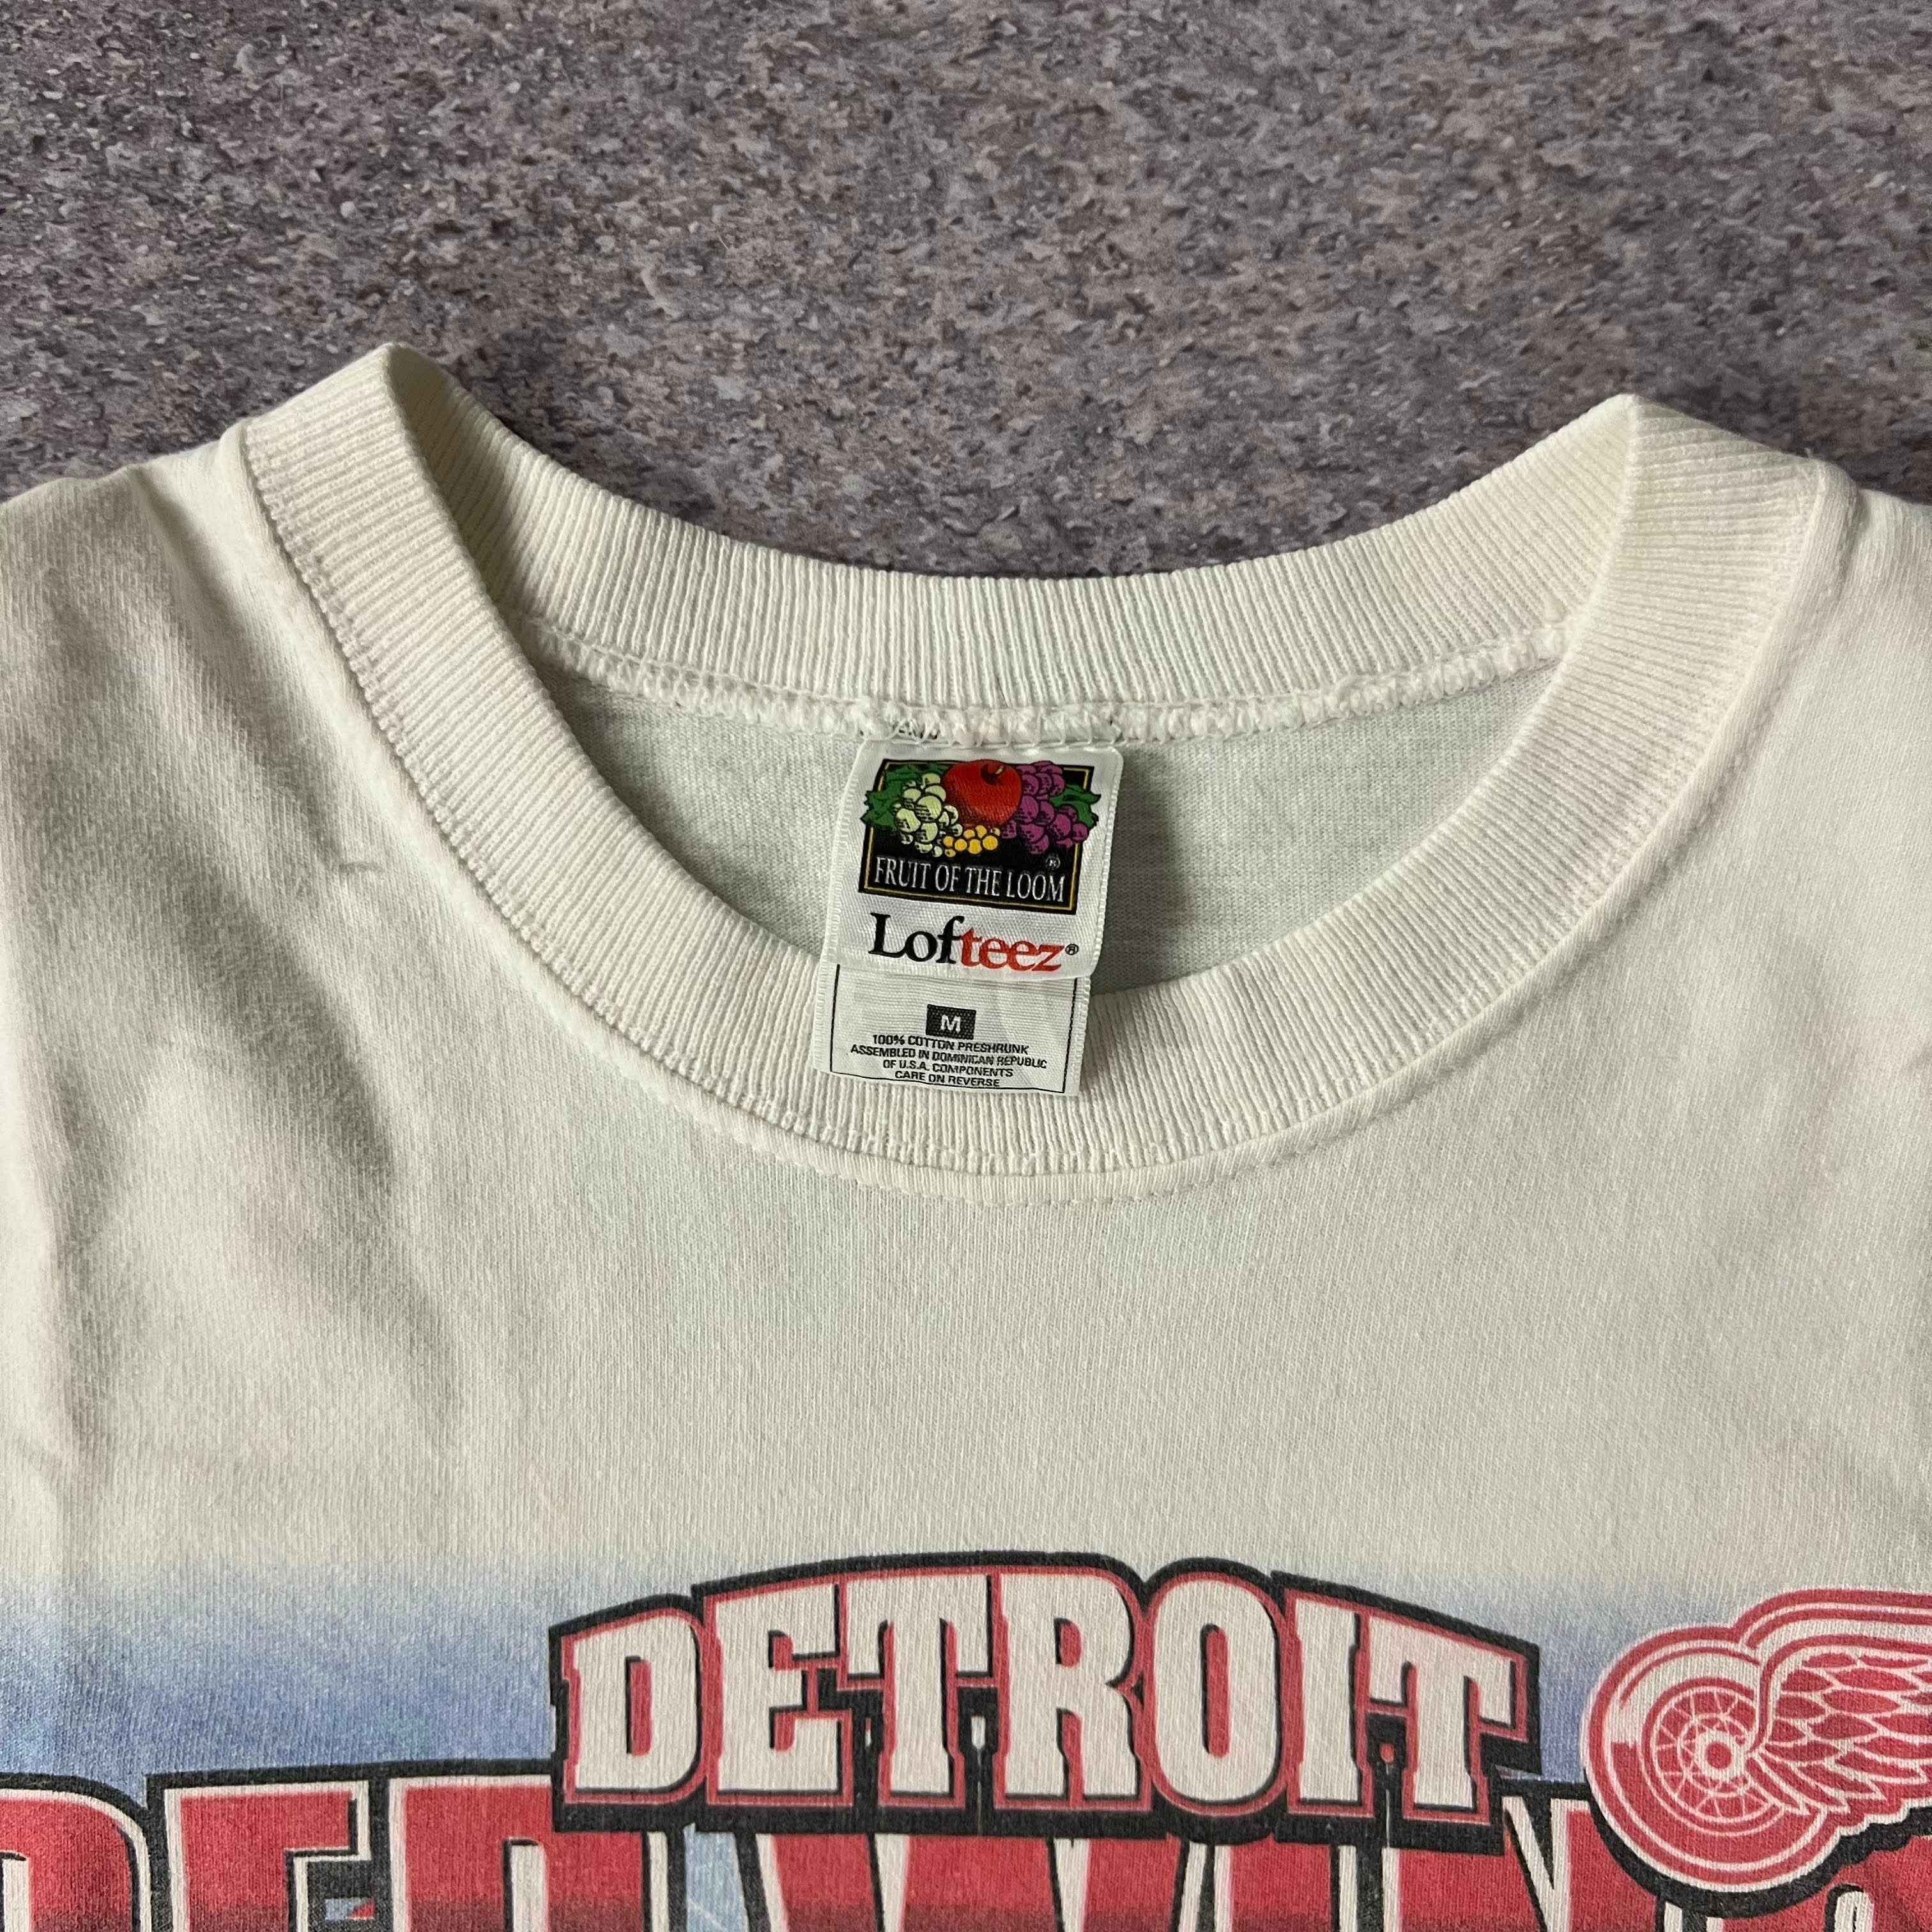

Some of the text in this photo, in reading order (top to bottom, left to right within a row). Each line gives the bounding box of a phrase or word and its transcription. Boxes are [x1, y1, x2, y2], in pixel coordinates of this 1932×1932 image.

[874, 856, 1066, 903] FRUIT OF THE LOOM
[868, 912, 1066, 972] Lofteez
[940, 1014, 961, 1033] M
[872, 1034, 1030, 1055] 100% COTTON PRESHRUNK
[850, 1044, 1048, 1069] ASSEMBLED IN DOMINICAN REPUBLIC
[883, 1059, 1014, 1077] OF U.S.A. COMPONENTS
[894, 1070, 1000, 1087] CARE ON REVERSE
[561, 1562, 1530, 1827] DETROIT
